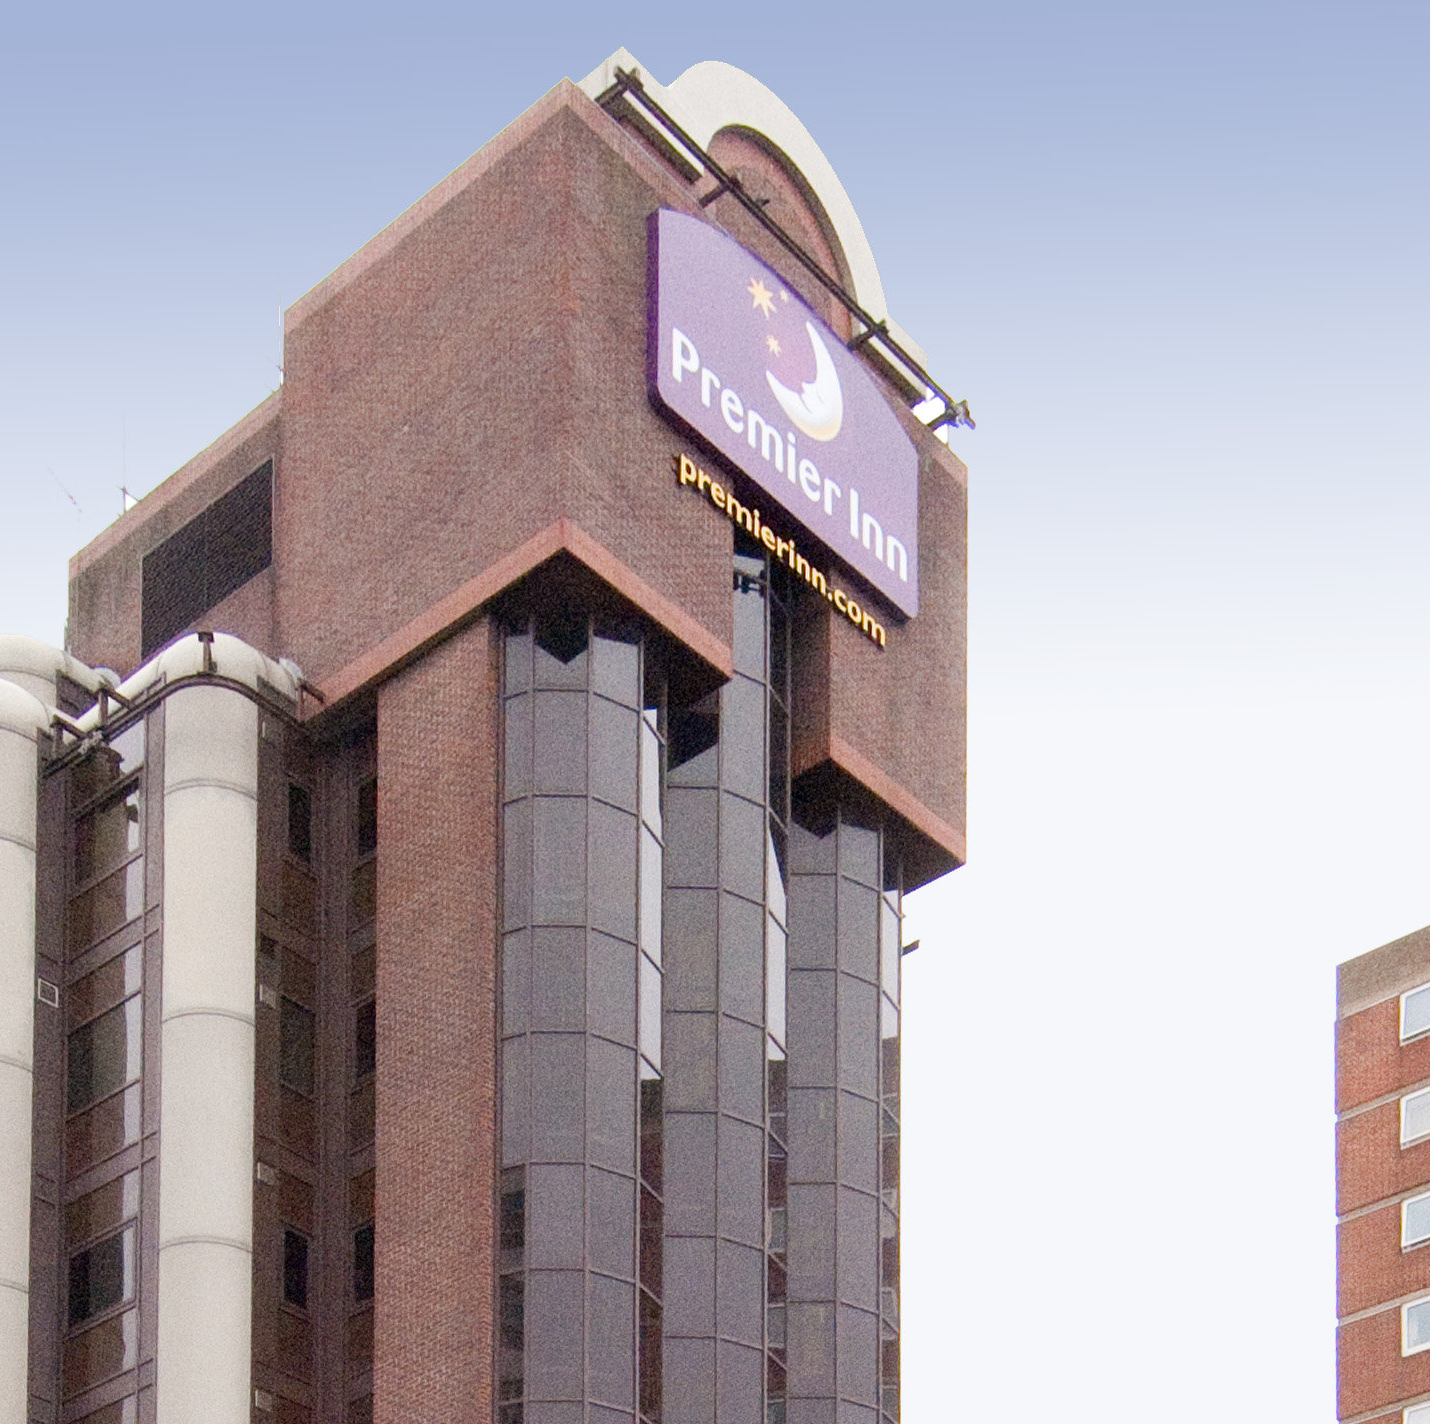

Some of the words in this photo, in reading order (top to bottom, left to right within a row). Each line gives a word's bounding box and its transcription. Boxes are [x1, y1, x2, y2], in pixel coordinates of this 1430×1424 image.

[672, 327, 842, 516] Premier
[850, 488, 909, 582] Inn
[678, 453, 887, 647] premierinn.com
